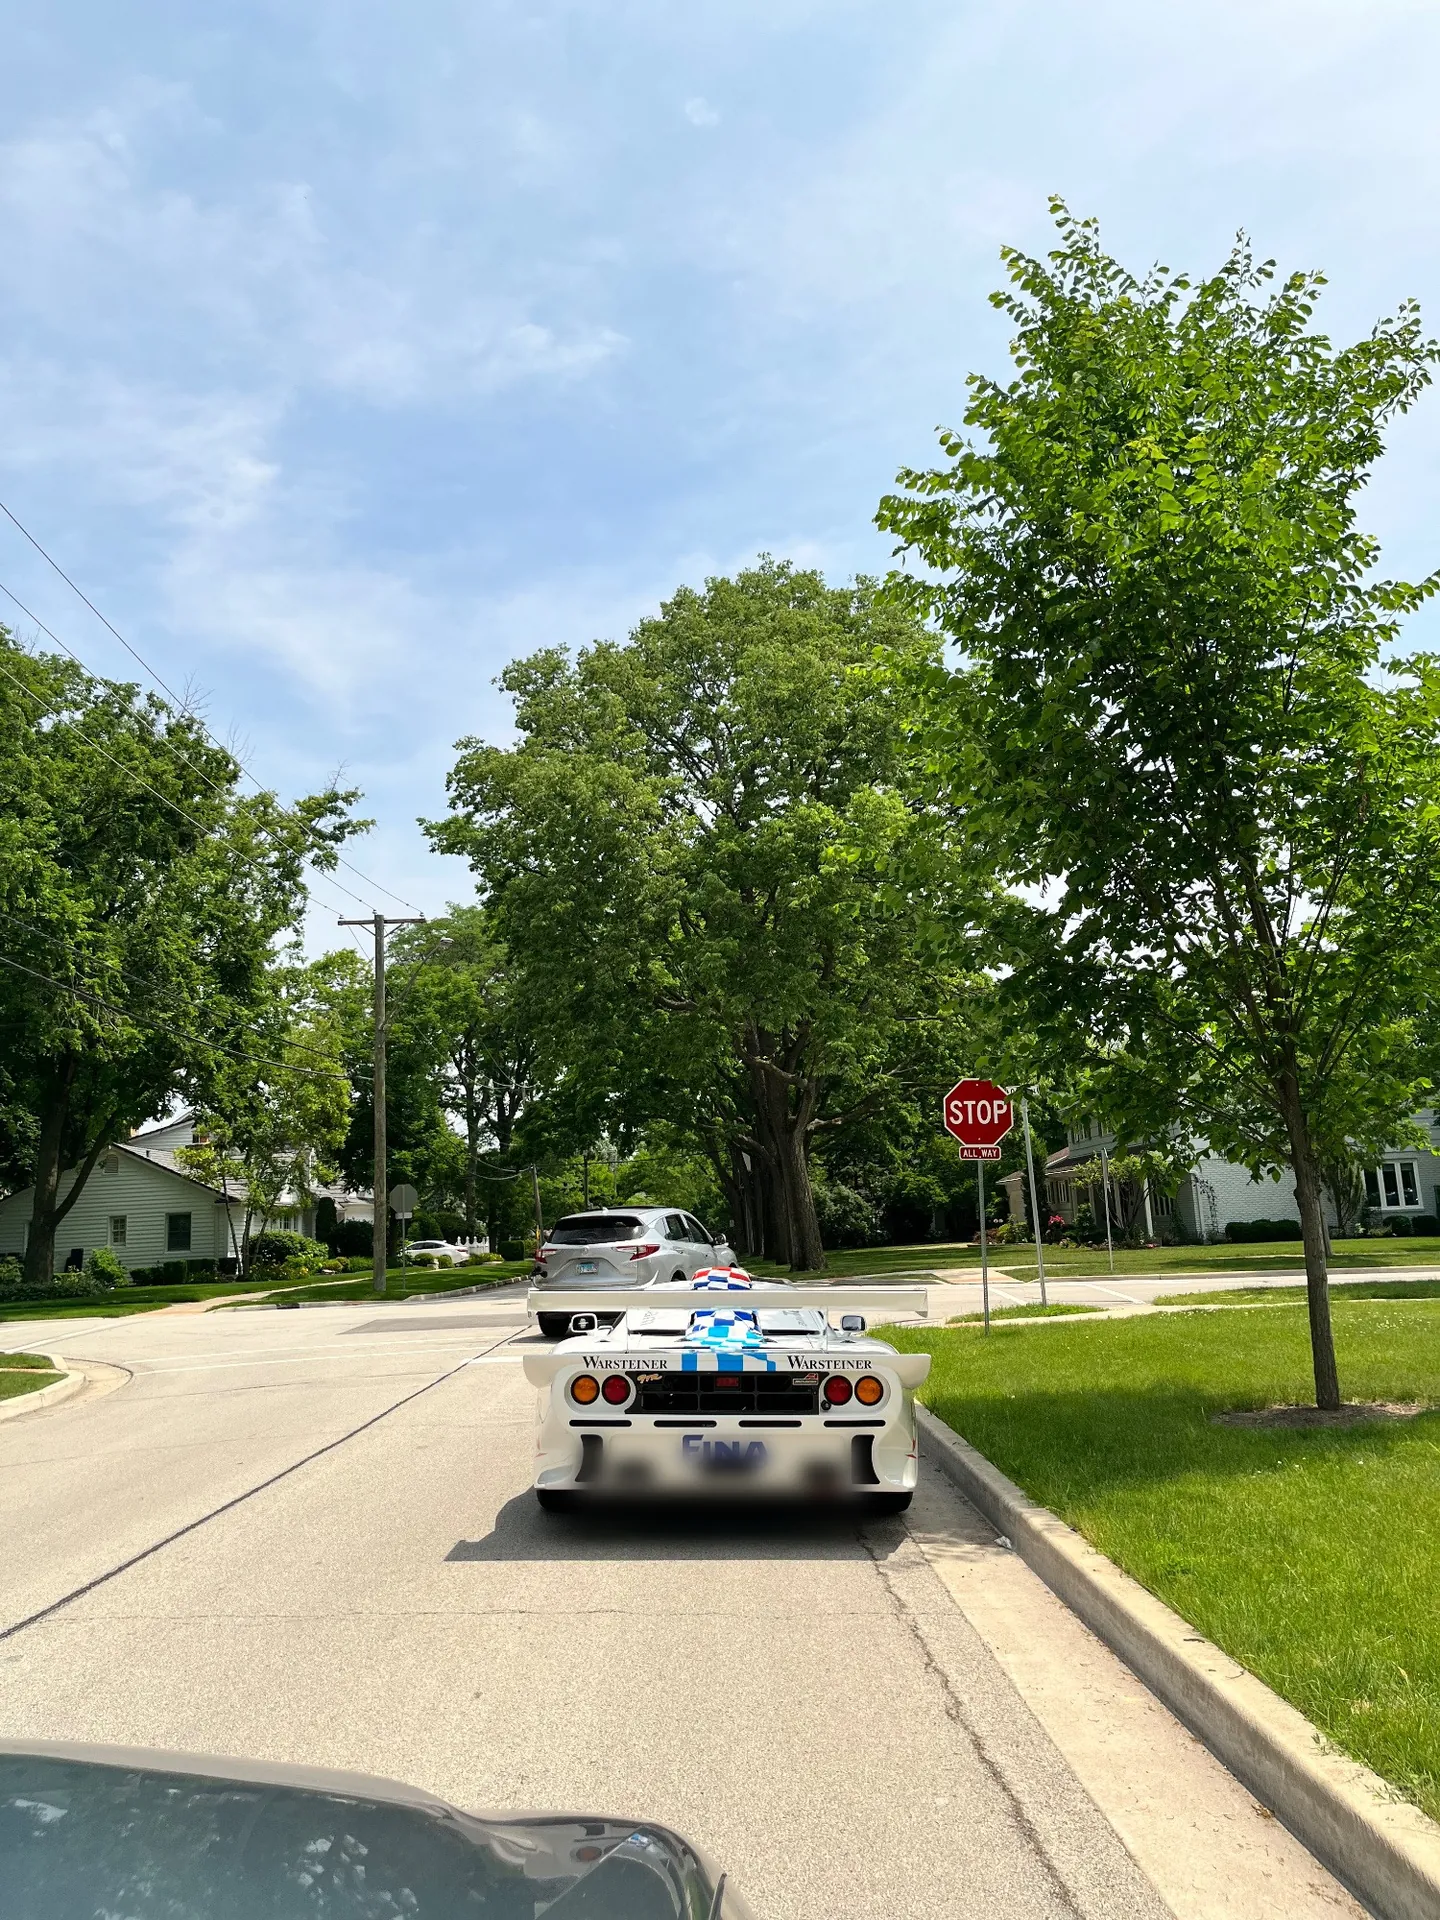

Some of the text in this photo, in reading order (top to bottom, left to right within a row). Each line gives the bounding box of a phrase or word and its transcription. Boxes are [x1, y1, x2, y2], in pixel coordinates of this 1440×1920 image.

[950, 1100, 1007, 1124] STOP
[963, 1149, 997, 1157] ALL WAY
[583, 1355, 667, 1369] WARSTEINER
[787, 1355, 872, 1369] WARSTEINER
[682, 1434, 769, 1464] FINA
